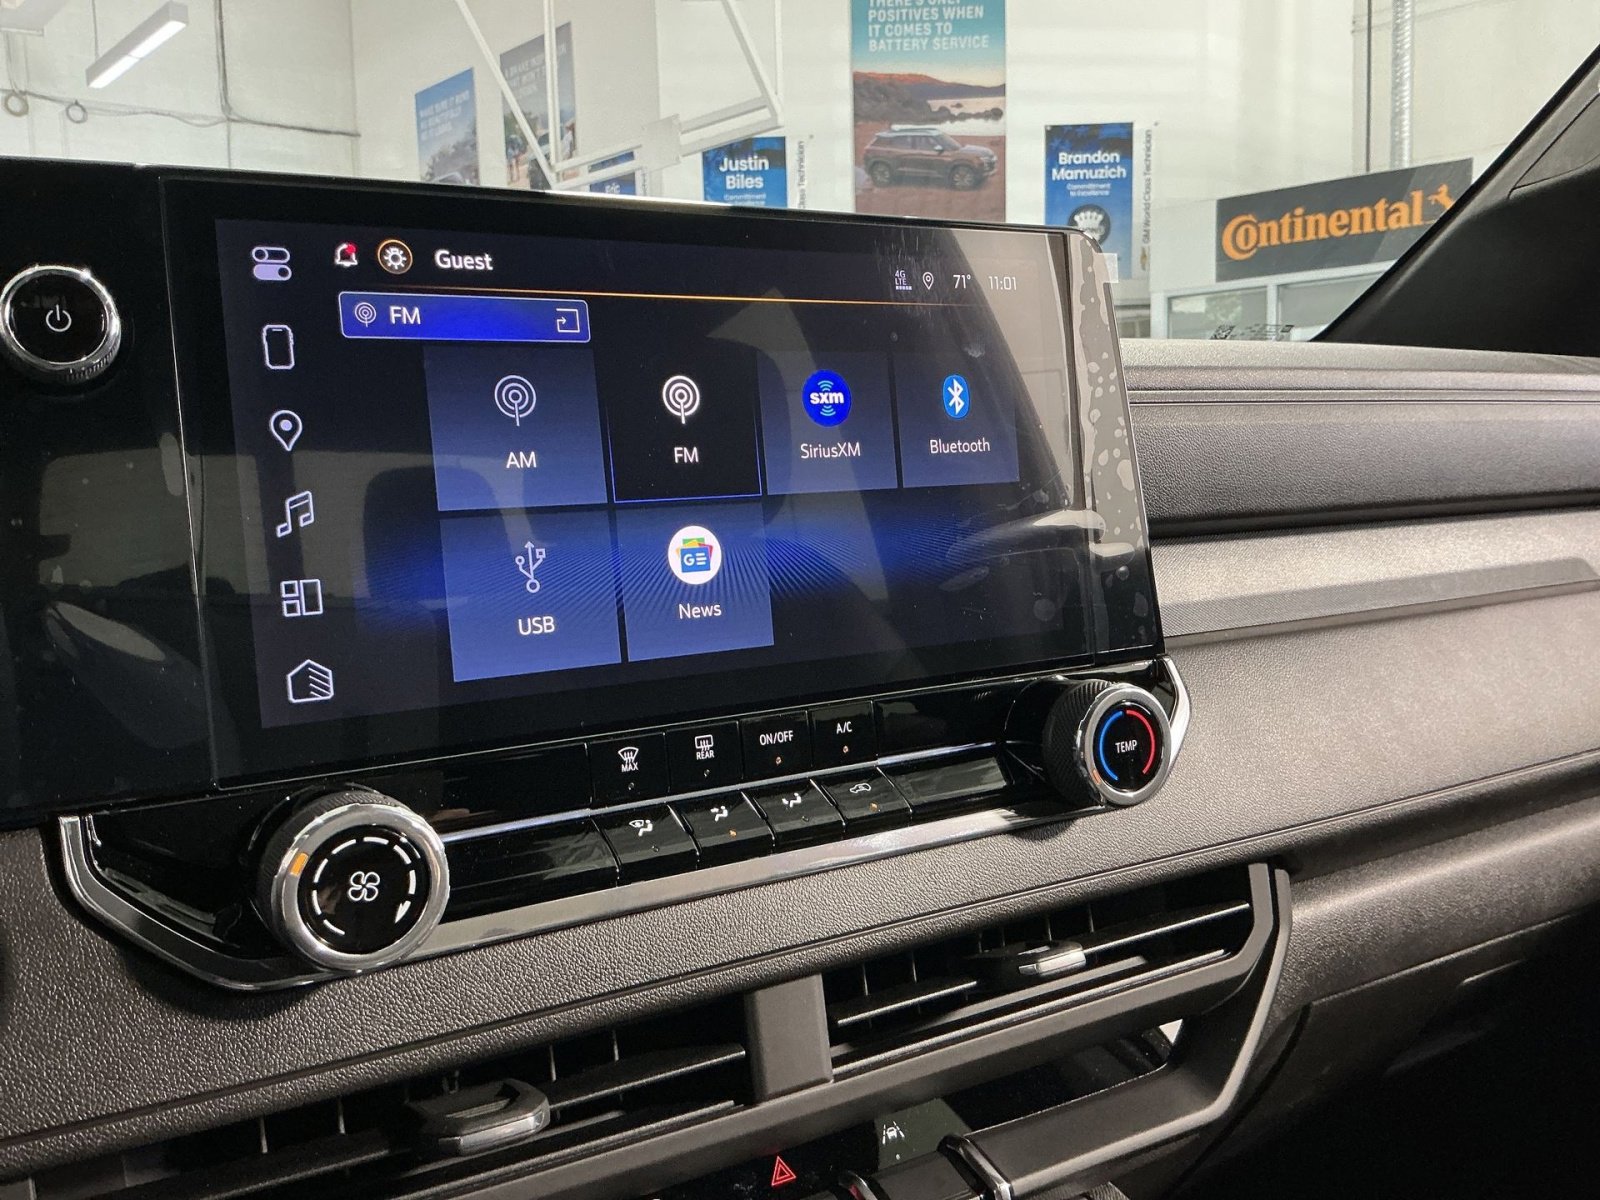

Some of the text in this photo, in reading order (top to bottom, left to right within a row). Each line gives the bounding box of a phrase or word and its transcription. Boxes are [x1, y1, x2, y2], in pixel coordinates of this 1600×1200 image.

[868, 6, 984, 22] POSITIVES WHEN
[868, 22, 953, 37] IT COMES TO
[869, 36, 989, 51] BATTERY SERVICE
[719, 155, 769, 172] Justin
[1058, 150, 1120, 165] Brandon
[1051, 165, 1127, 181] Mamuzich
[725, 173, 764, 190] Biles
[1142, 130, 1152, 244] GM World Class Technician
[1222, 189, 1424, 261] Continental
[434, 249, 494, 271] Guest
[895, 270, 906, 278] 4G
[895, 278, 907, 286] LTE
[953, 274, 971, 289] 71°
[988, 276, 1017, 290] 11:01
[389, 306, 421, 325] FM
[809, 391, 844, 405] sxm
[800, 441, 861, 459] SiriusXM
[929, 437, 991, 454] Bluetooth
[506, 451, 537, 469] AM
[674, 446, 699, 464] FM
[678, 603, 722, 619] News
[518, 616, 555, 635] USB
[836, 721, 853, 734] A/C
[759, 730, 794, 746] ON/OFF
[696, 750, 715, 760] REAR
[1114, 740, 1138, 754] TEMP
[621, 762, 639, 773] MAX
